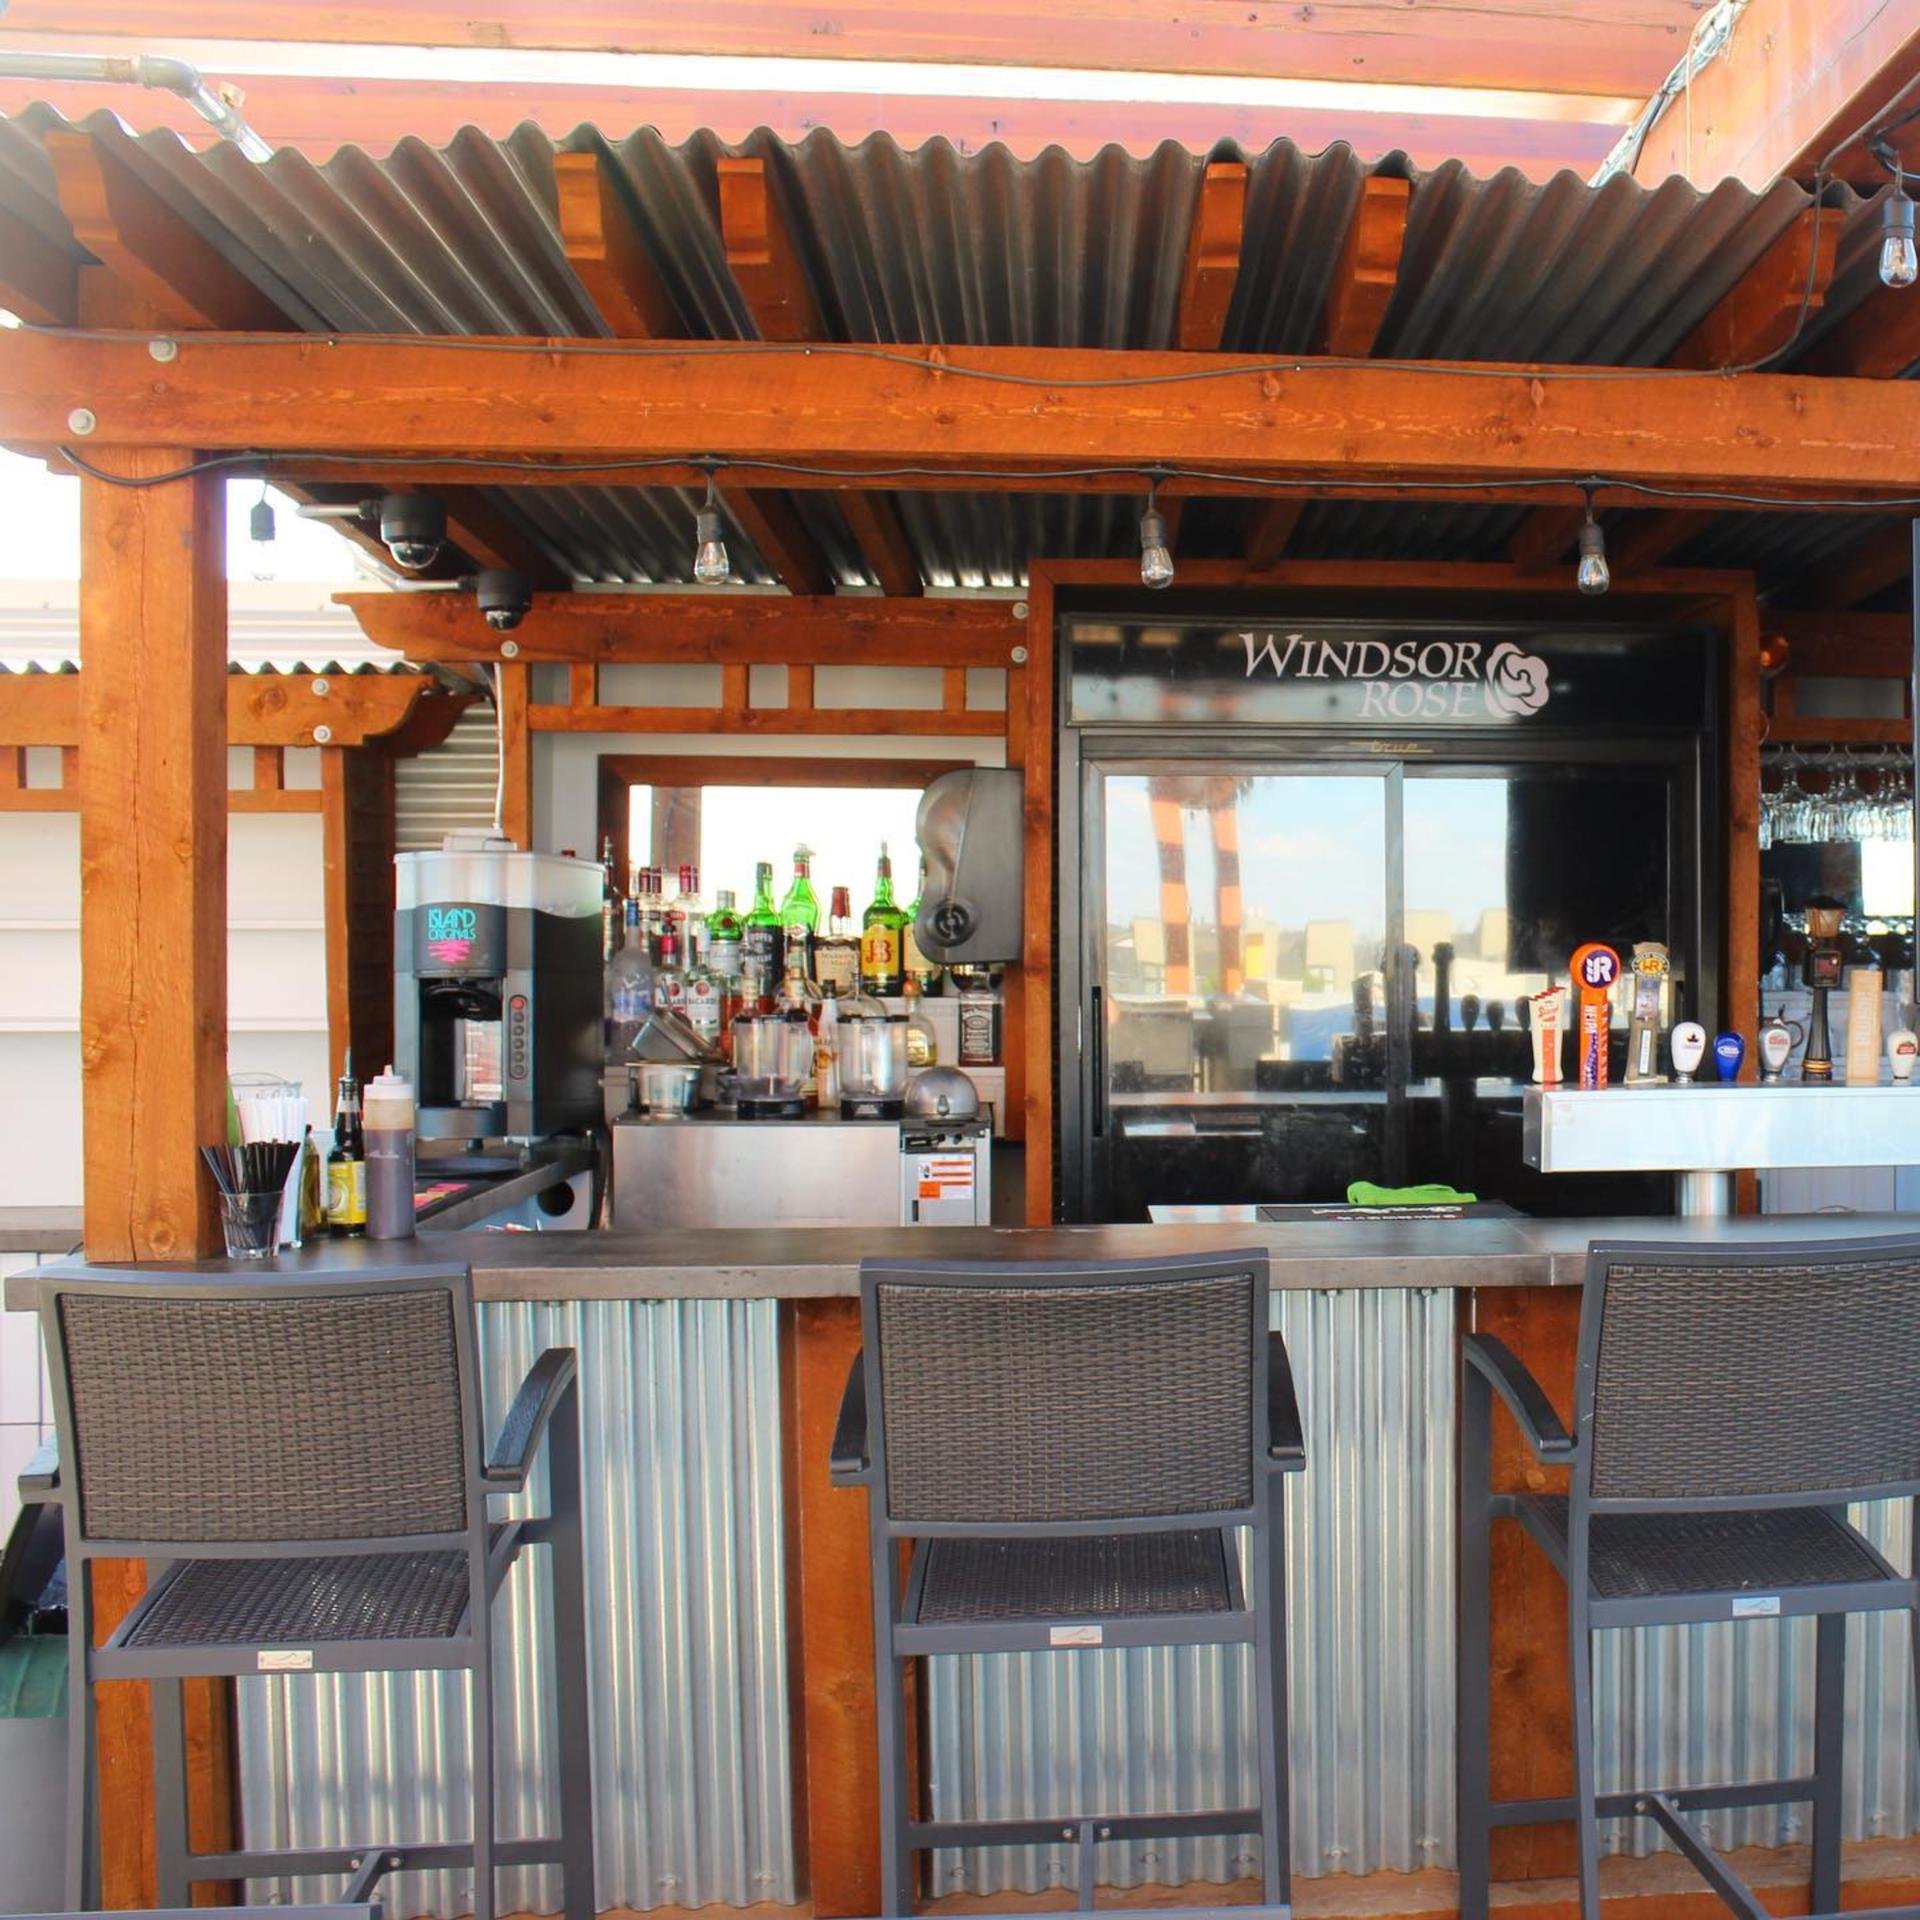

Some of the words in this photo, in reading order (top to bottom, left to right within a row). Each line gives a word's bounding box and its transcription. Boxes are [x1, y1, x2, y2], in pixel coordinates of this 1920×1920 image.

[1239, 632, 1482, 678] WINDSOR
[1357, 681, 1479, 718] ROSE
[428, 908, 476, 928] ISLAND
